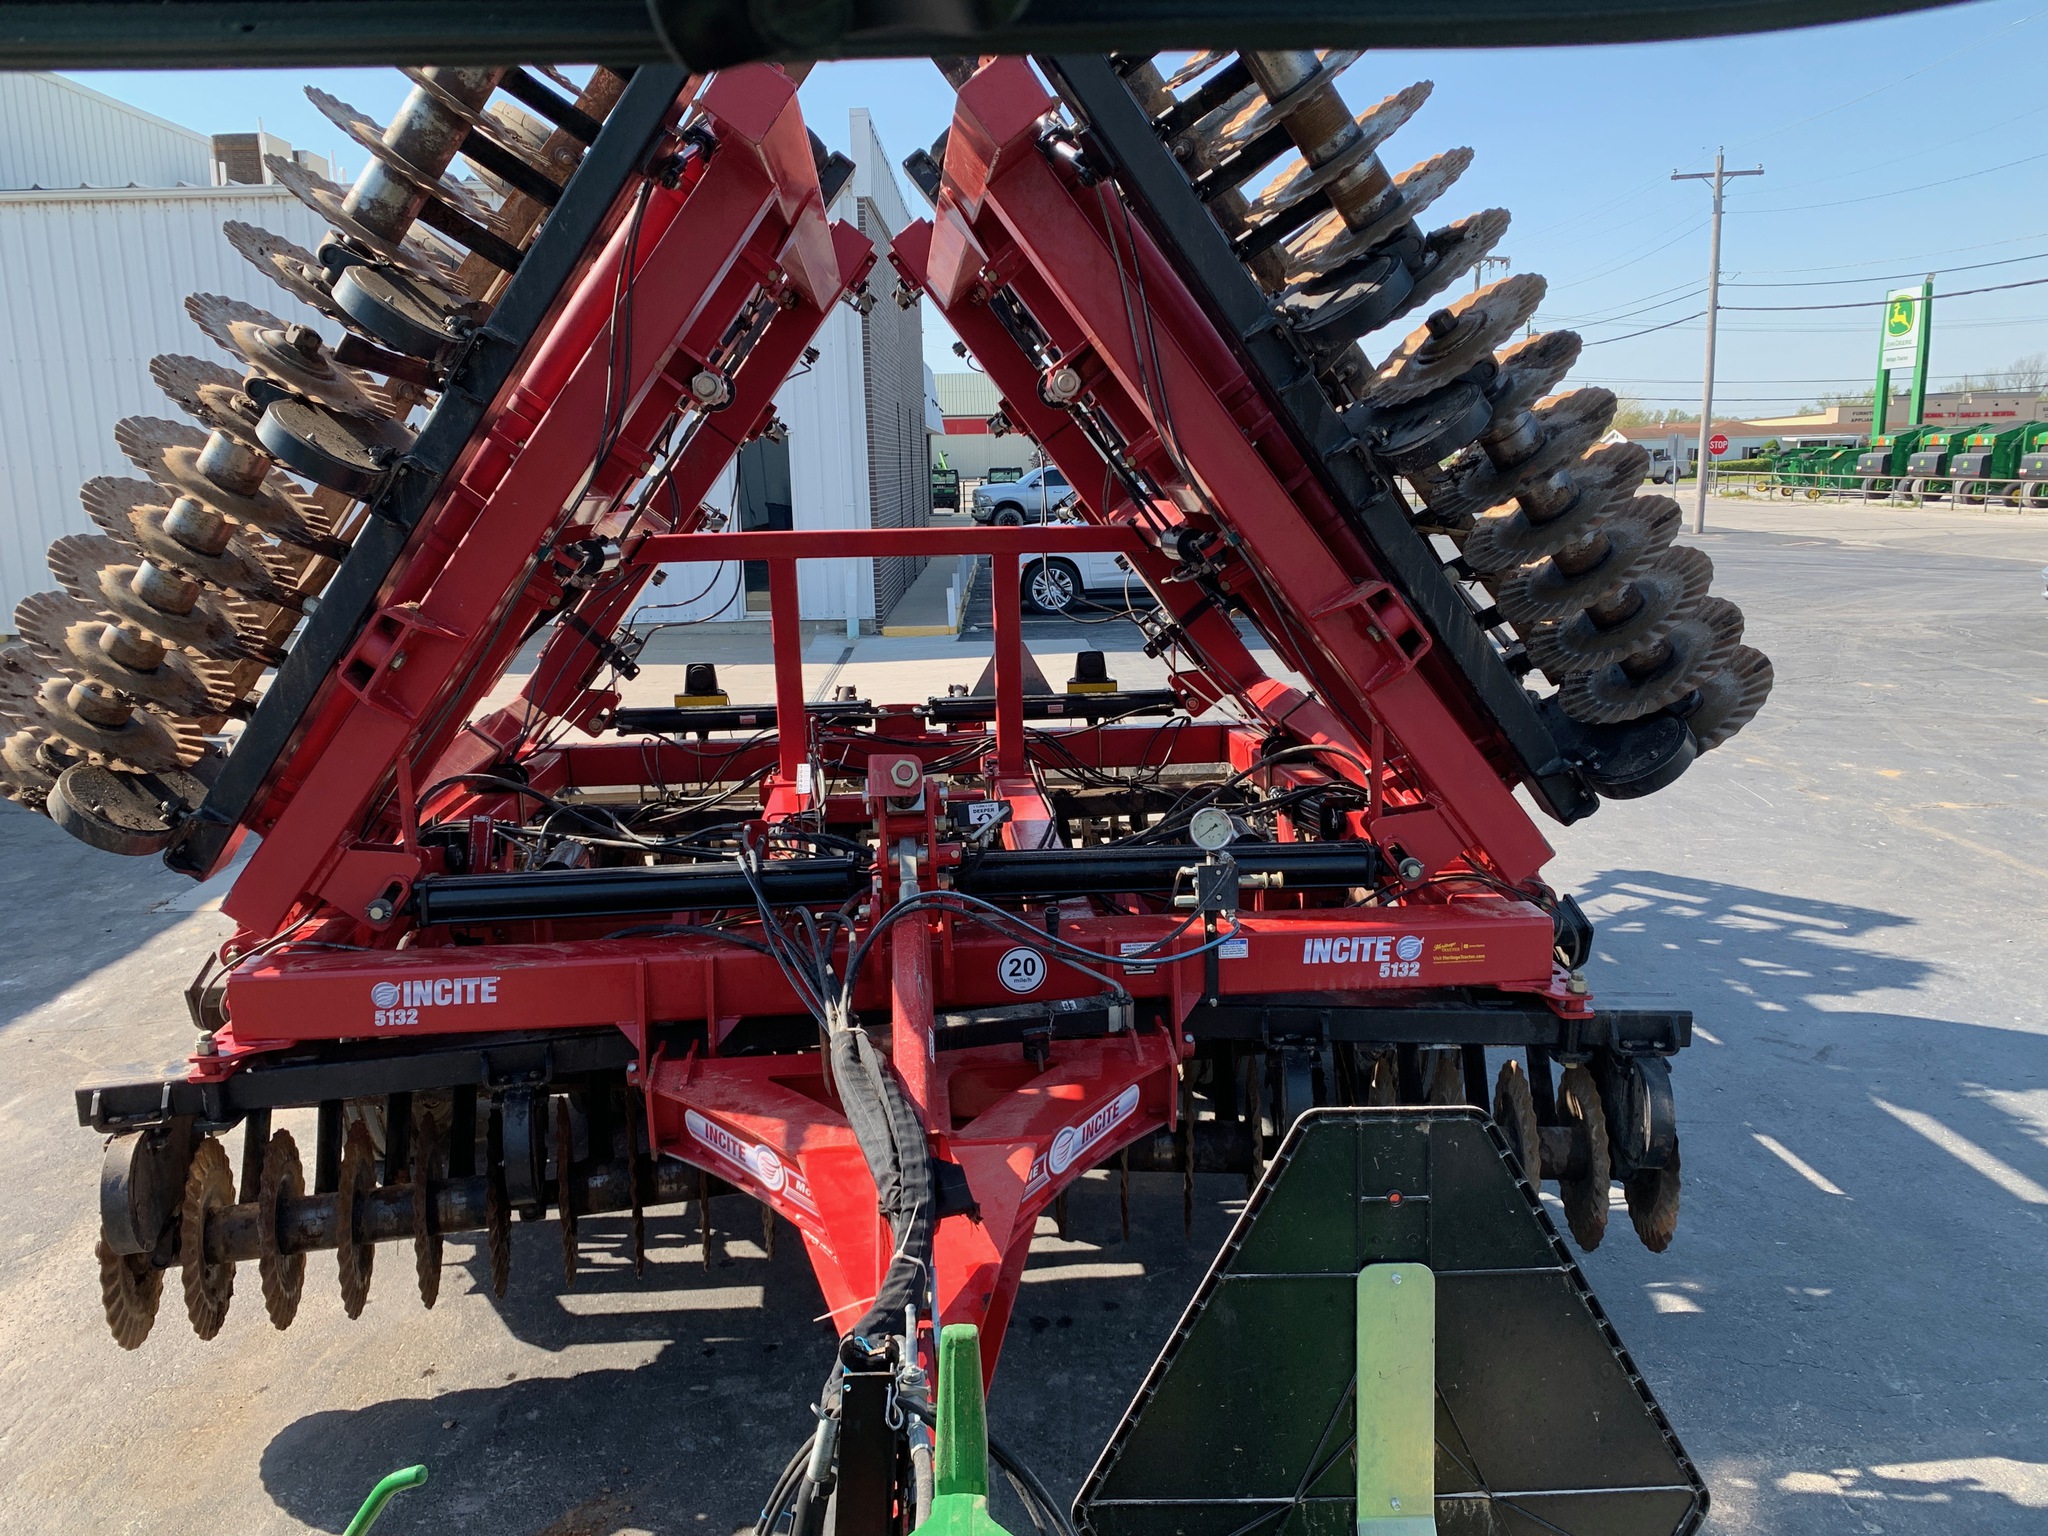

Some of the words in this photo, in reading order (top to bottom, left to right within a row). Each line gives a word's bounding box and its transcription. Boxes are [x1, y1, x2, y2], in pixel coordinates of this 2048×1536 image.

[1709, 440, 1728, 449] STOP
[1303, 936, 1392, 964] INCITE
[1008, 957, 1036, 977] 20
[1379, 961, 1420, 978] 5132
[403, 976, 498, 1007] INCITE
[374, 1008, 418, 1026] 5132
[1081, 1100, 1120, 1144] INCITE
[704, 1122, 747, 1163] INCITE
[795, 1180, 812, 1198] Mc
